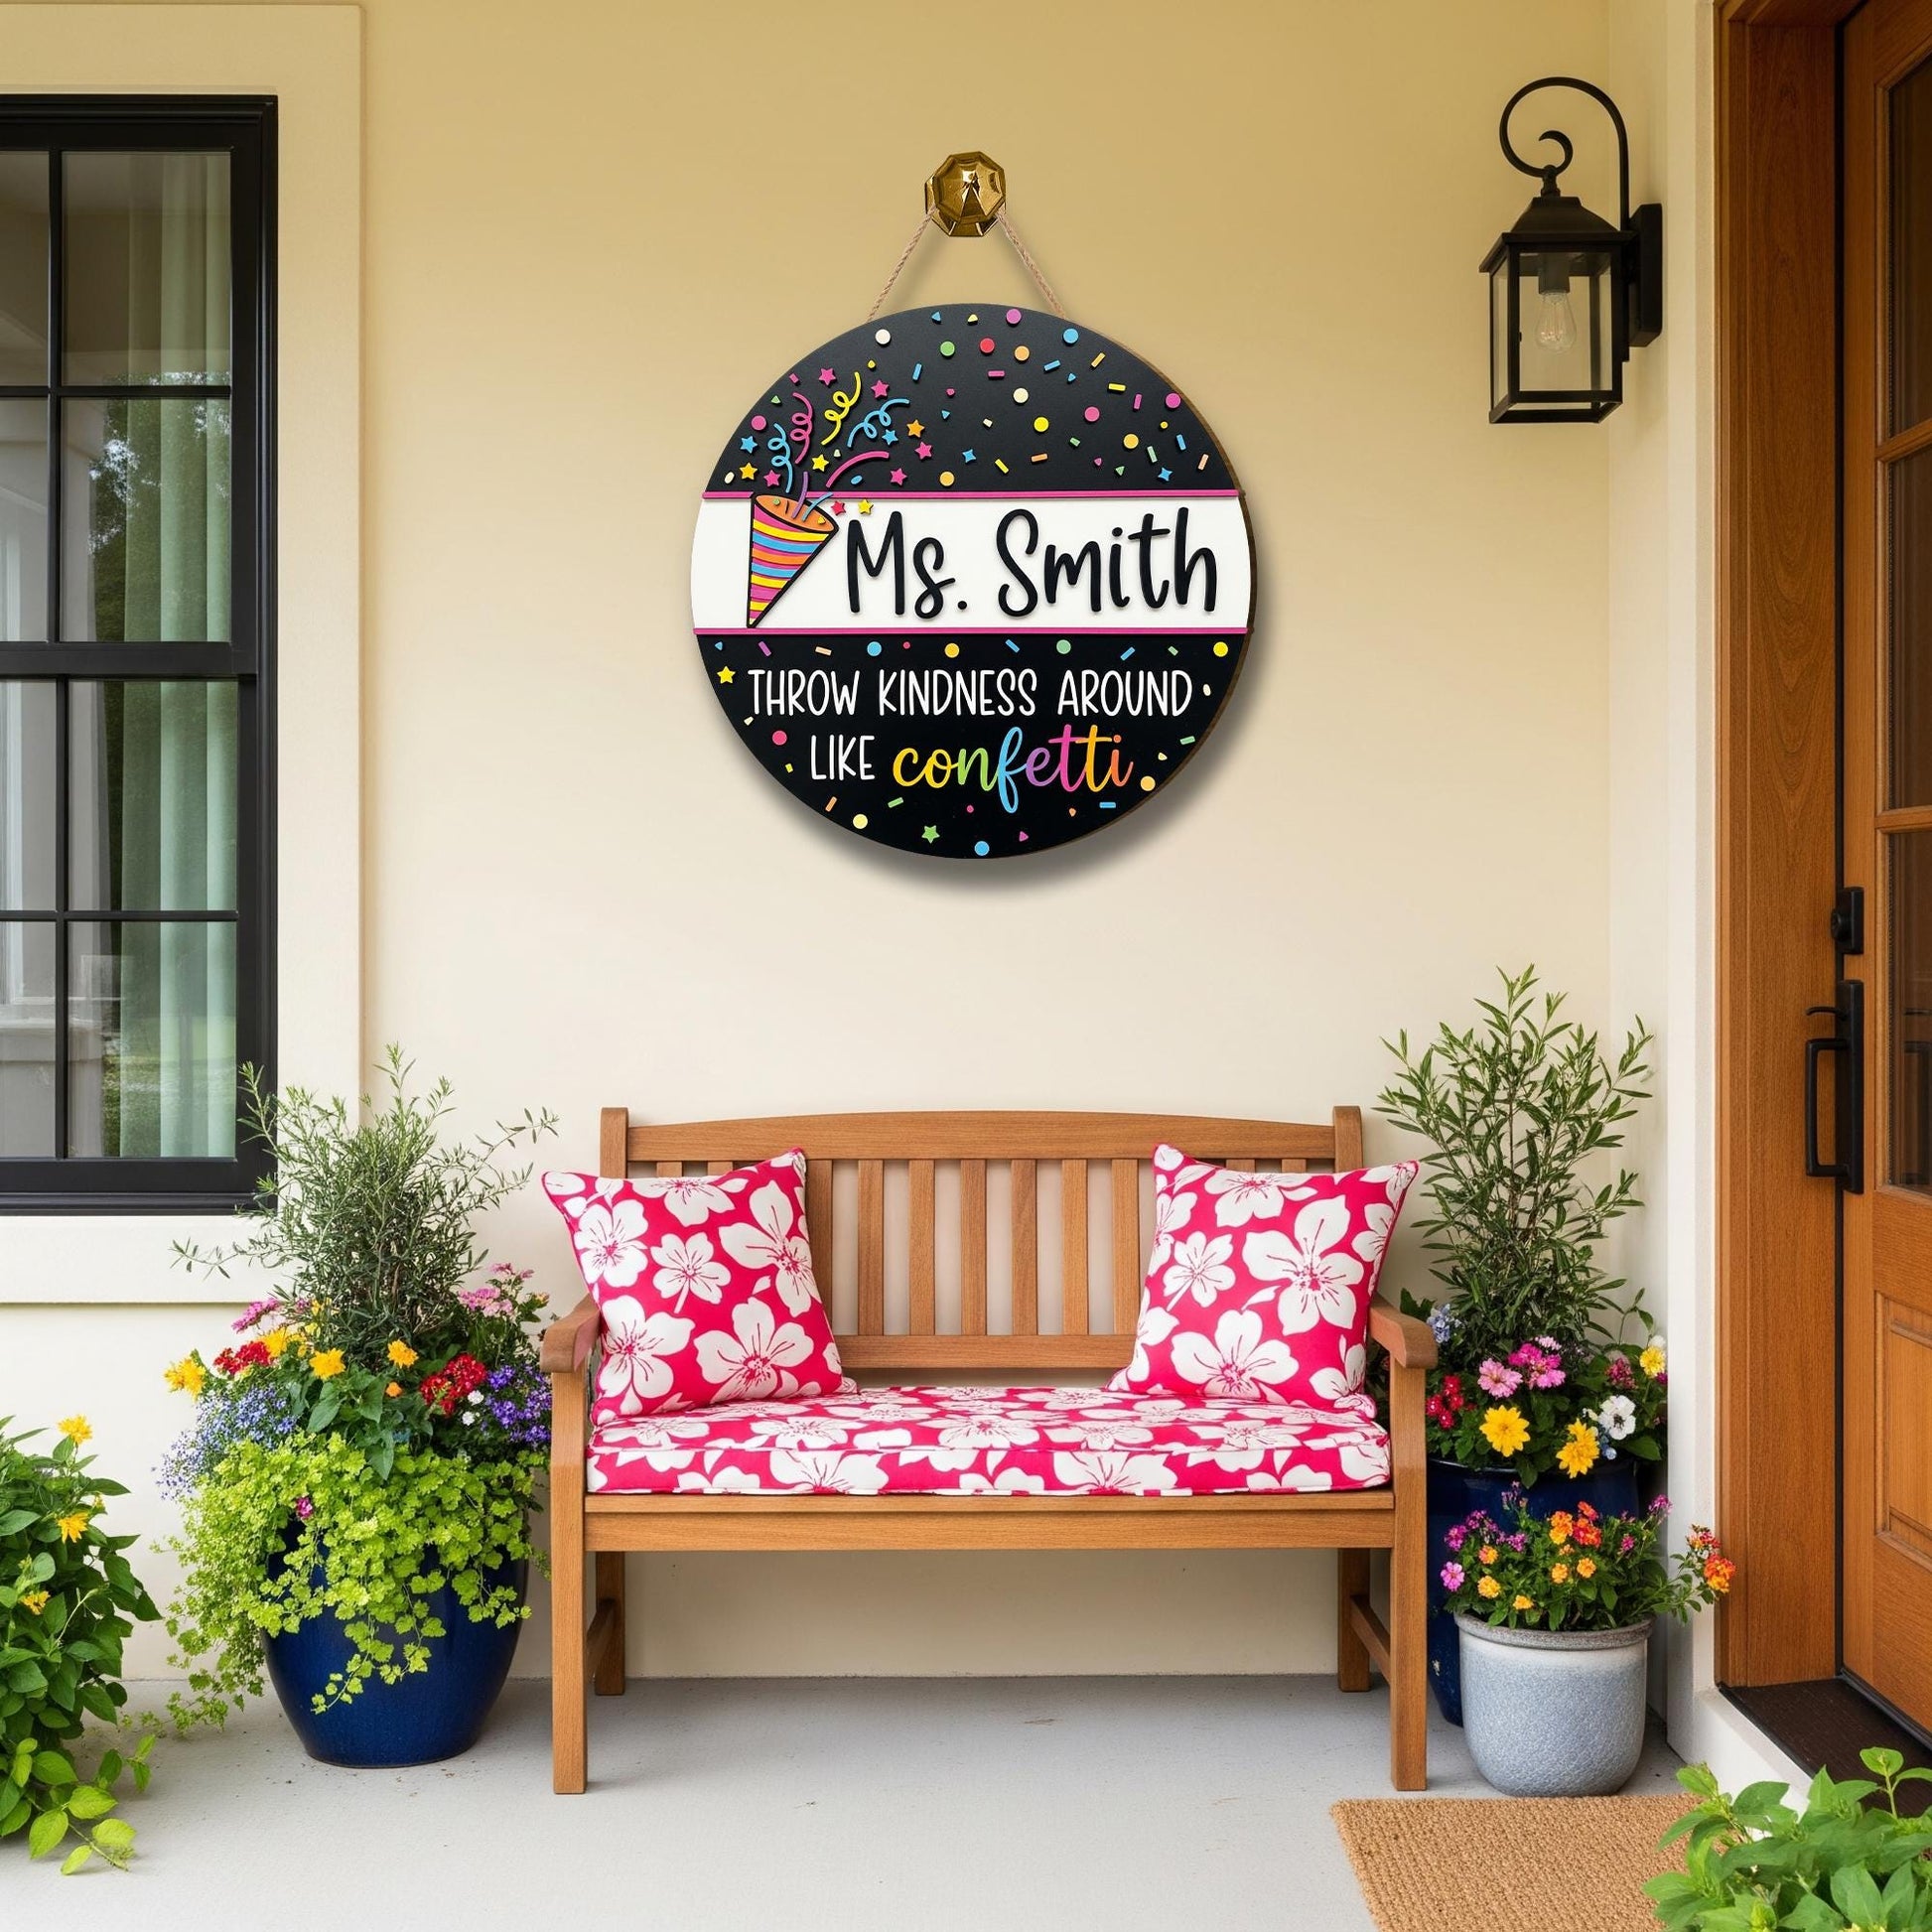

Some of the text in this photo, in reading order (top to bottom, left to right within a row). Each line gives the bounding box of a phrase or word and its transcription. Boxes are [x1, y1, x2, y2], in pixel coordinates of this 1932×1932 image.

[847, 506, 1217, 621] Ms. Smith
[748, 668, 1193, 717] THROW KINDNESS AROUND
[810, 724, 1134, 814] LIKE confetti
